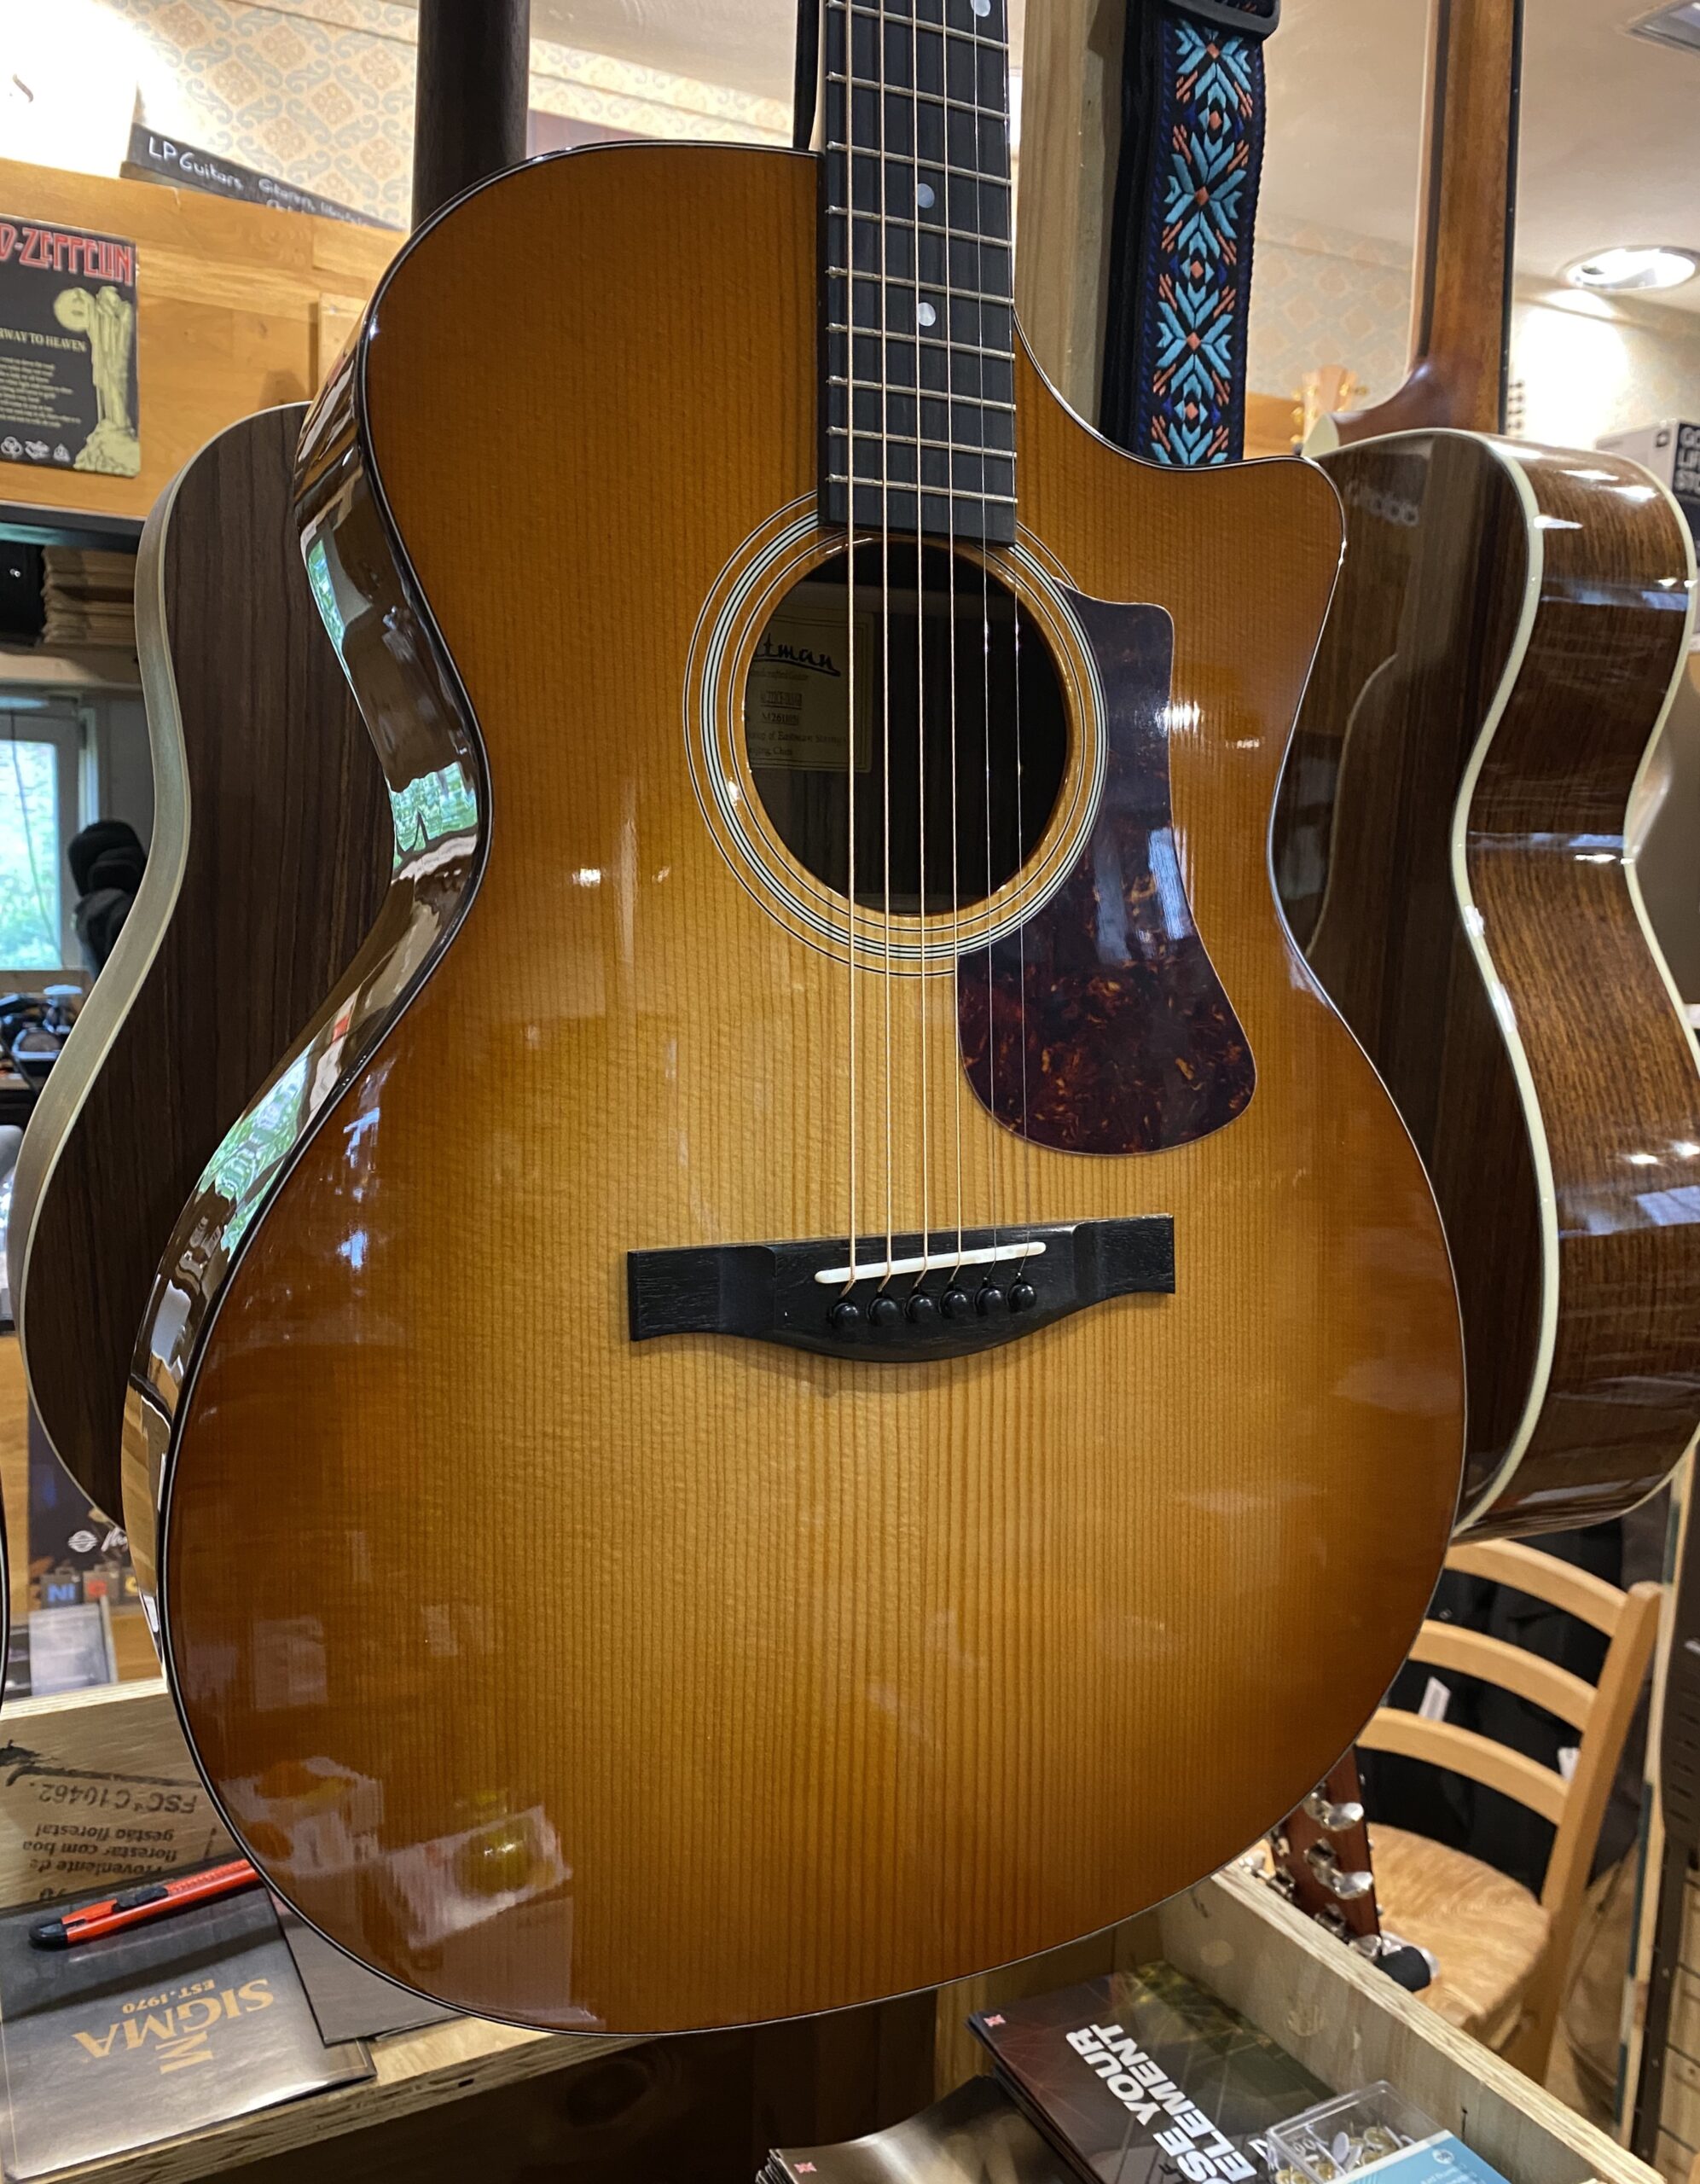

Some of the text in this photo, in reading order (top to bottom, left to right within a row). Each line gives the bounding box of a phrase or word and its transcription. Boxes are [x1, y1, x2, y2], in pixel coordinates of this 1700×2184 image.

[148, 136, 177, 161] LP
[28, 332, 44, 346] TO
[45, 335, 87, 352] HEAVEN
[754, 633, 834, 671] tman
[35, 1823, 111, 1842] florestal
[23, 1840, 56, 1856] boa
[61, 1842, 98, 1854] com
[72, 1978, 274, 2058] SIGMA
[1066, 2025, 1231, 2184] SE YOUR
[1089, 2024, 1257, 2182] ELEMENT
